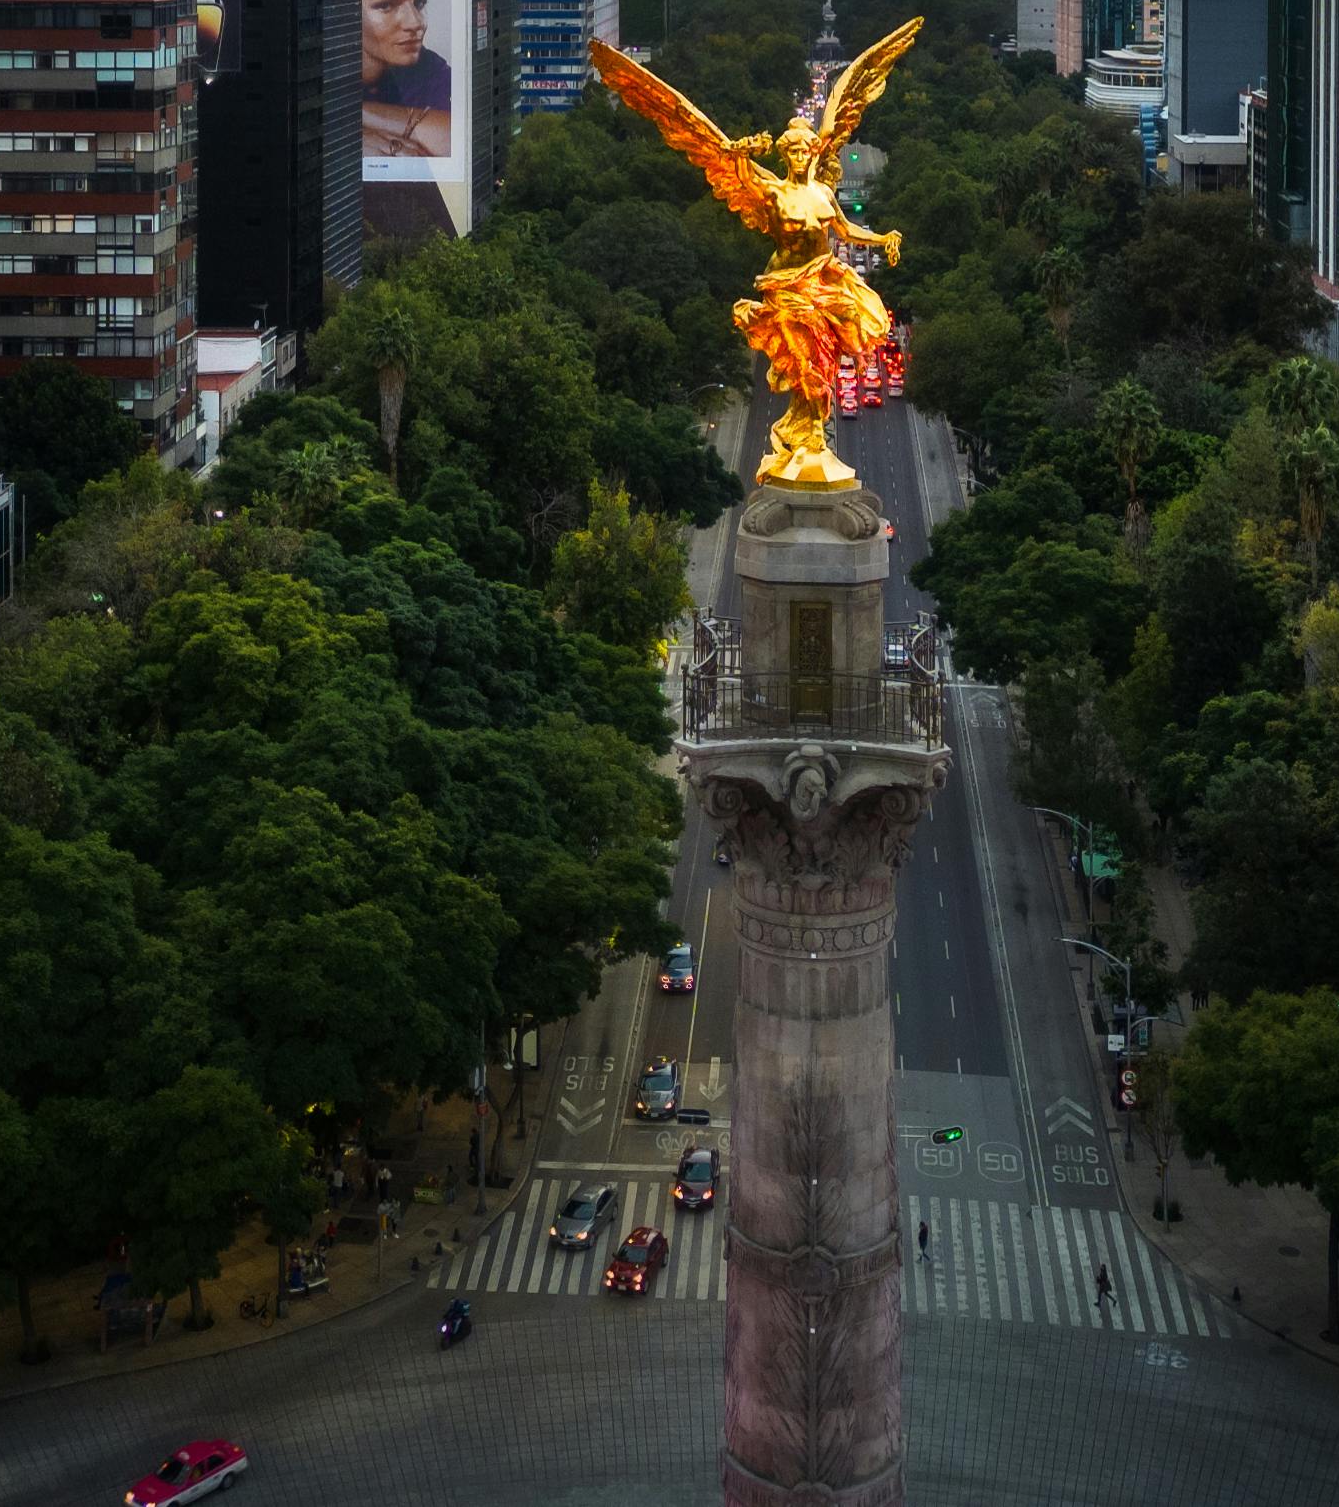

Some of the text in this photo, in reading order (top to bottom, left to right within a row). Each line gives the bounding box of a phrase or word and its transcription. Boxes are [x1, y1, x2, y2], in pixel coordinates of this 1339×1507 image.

[532, 80, 569, 89] RENTA
[922, 1148, 954, 1167] 50
[983, 1153, 1018, 1173] 50
[1055, 1144, 1099, 1165] BUS
[1052, 1165, 1110, 1186] SOLO
